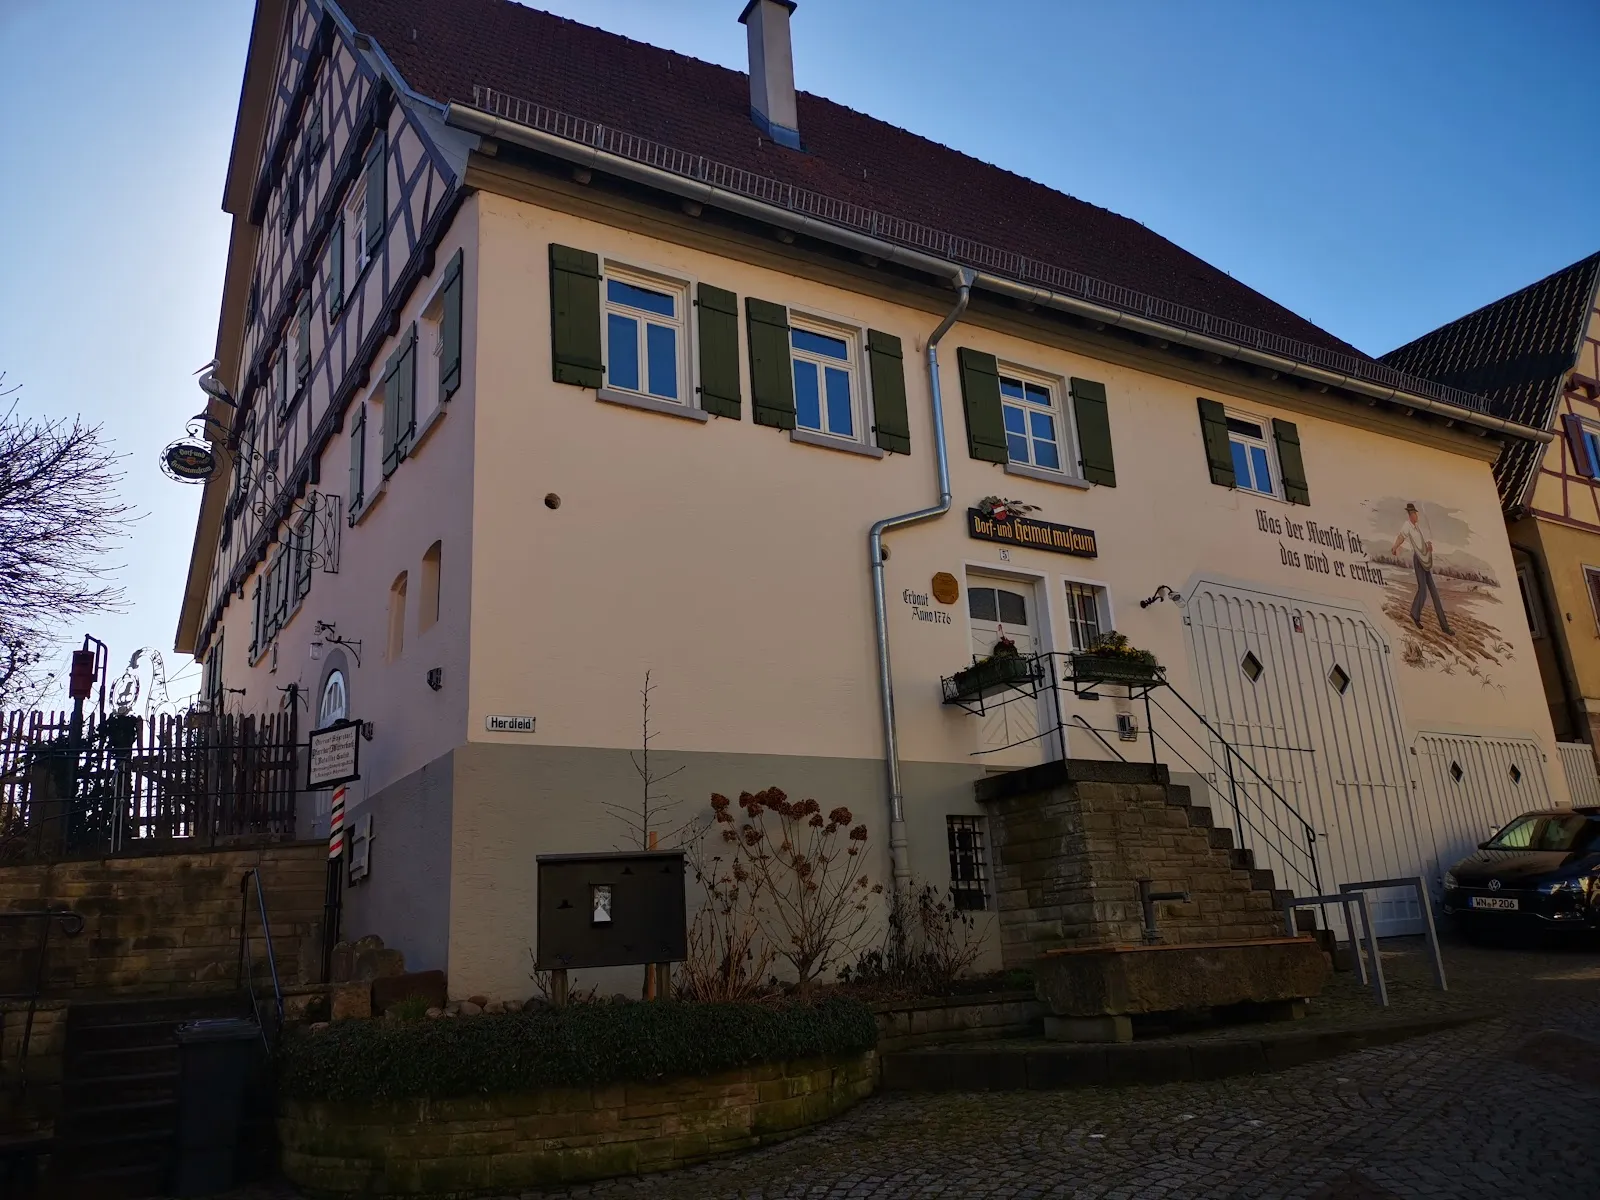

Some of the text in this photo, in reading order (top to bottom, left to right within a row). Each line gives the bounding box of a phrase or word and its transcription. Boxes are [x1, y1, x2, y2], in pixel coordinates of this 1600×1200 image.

[1255, 508, 1282, 535] Was
[1284, 513, 1305, 541] der
[1278, 539, 1389, 586] das wird er ernten.
[903, 589, 928, 607] Erbaut
[911, 606, 952, 625] Anno 1776
[491, 716, 531, 730] Herdfeld
[1475, 898, 1515, 909] WN P 206
